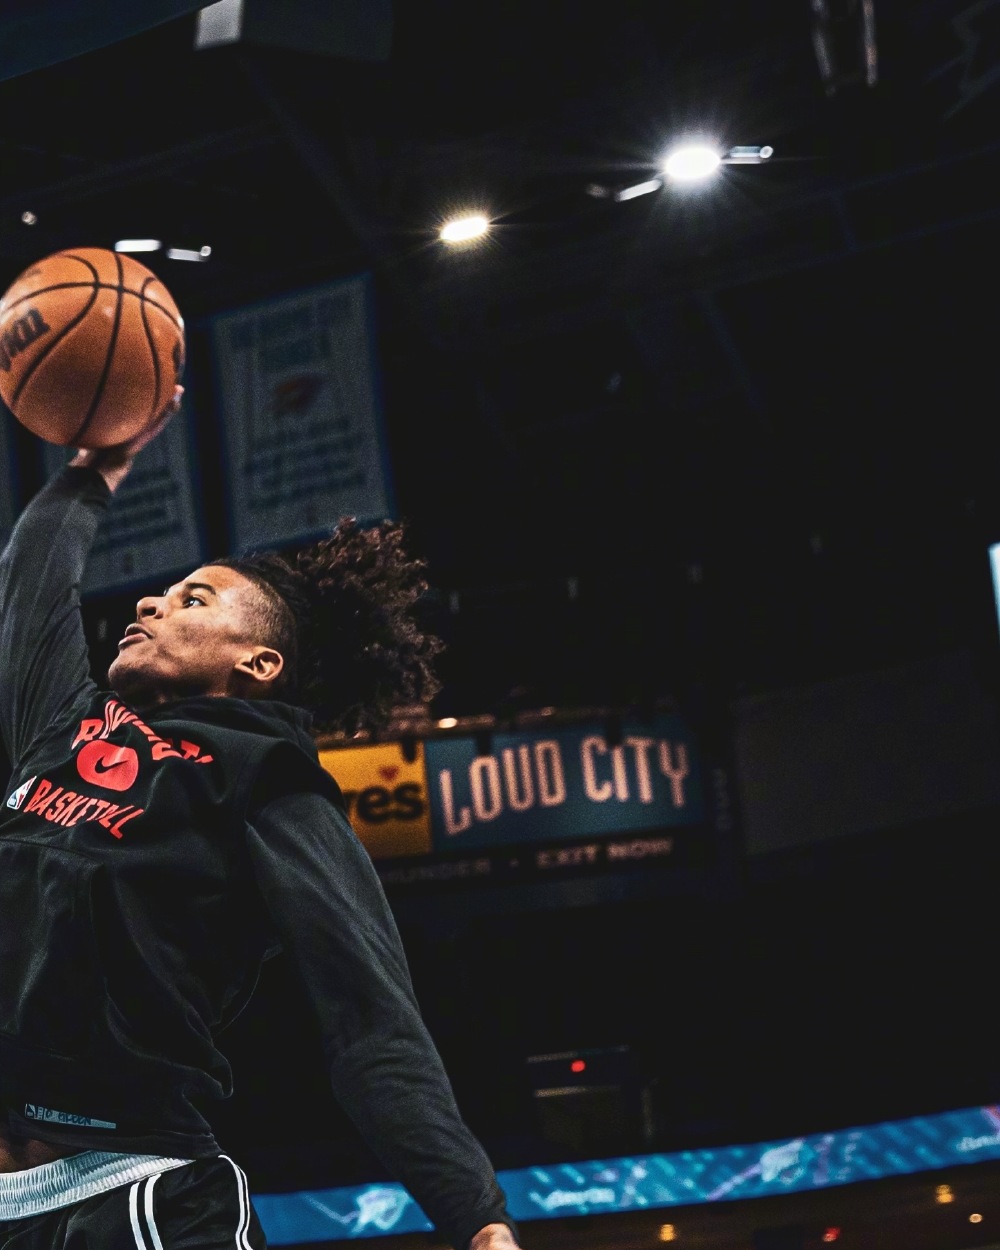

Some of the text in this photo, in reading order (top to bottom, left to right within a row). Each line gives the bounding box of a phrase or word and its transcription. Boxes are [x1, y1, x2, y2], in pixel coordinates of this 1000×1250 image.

[439, 738, 568, 836] LOUD
[579, 735, 691, 809] CITY
[536, 845, 598, 869] EXIT
[606, 837, 674, 862] NOW
